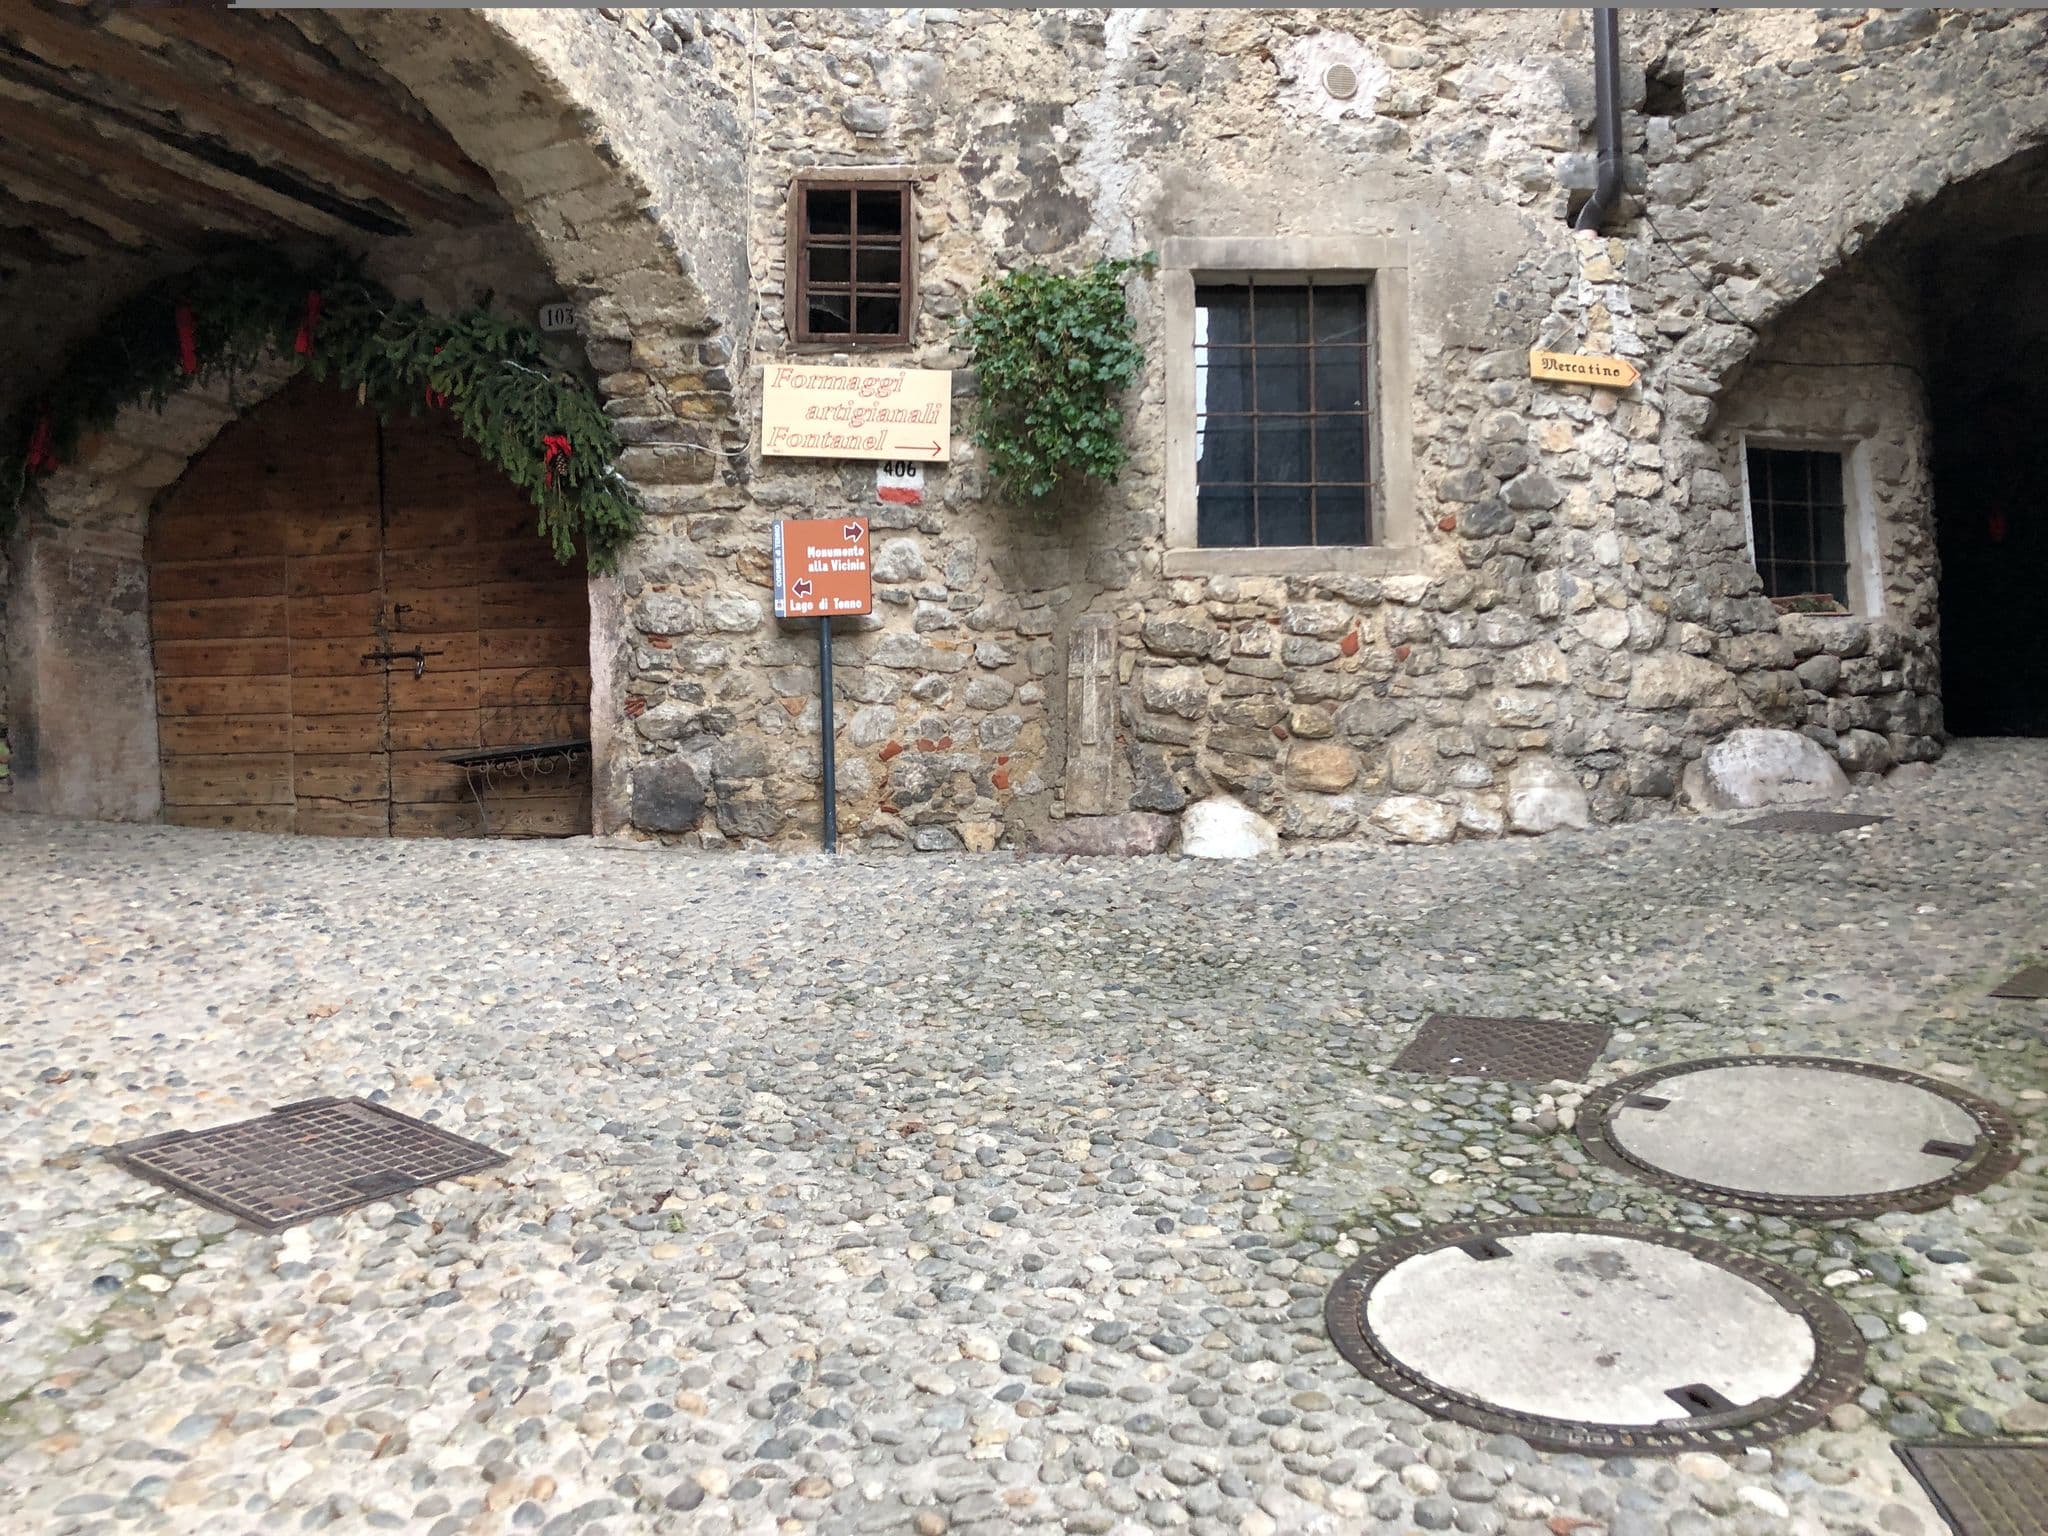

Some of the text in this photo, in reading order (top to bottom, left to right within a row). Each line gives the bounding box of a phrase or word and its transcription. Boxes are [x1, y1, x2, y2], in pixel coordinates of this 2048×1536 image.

[547, 307, 574, 326] 103
[1541, 357, 1621, 377] Mercatino
[771, 367, 906, 398] Formaggi
[805, 400, 942, 428] artigianali
[767, 426, 889, 451] Fontanel
[883, 460, 916, 477] 406
[807, 545, 864, 558] Monumento
[808, 559, 866, 572] alla Vicinia
[790, 598, 862, 613] Lago di Tenno
